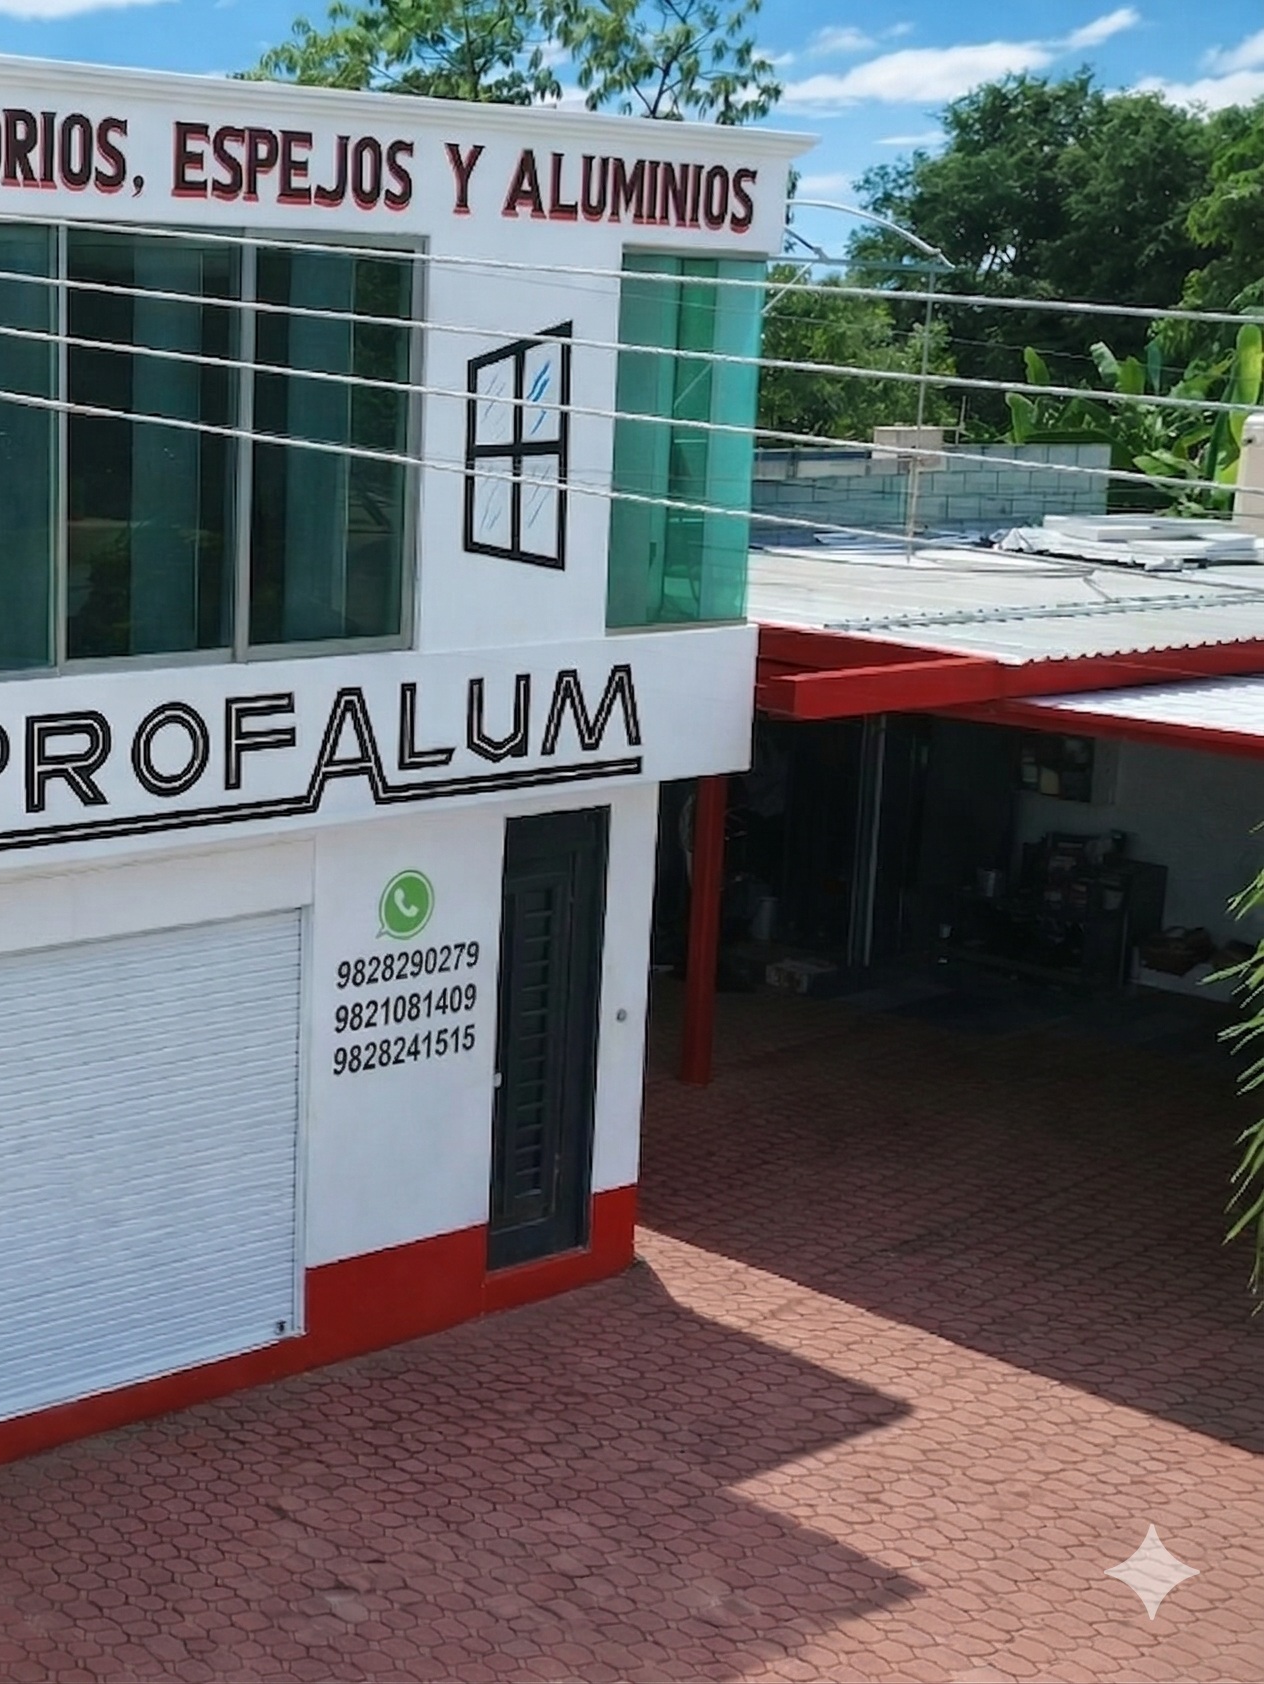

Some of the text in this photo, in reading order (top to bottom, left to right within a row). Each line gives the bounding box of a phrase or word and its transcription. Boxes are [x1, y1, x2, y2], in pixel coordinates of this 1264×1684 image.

[171, 121, 415, 213] ESPEJOS
[444, 142, 486, 215] Y
[501, 148, 758, 234] ALUMINIOS
[336, 941, 480, 990] 9828290279
[334, 983, 478, 1034] 9821081409
[332, 1024, 476, 1076] 9828241515
